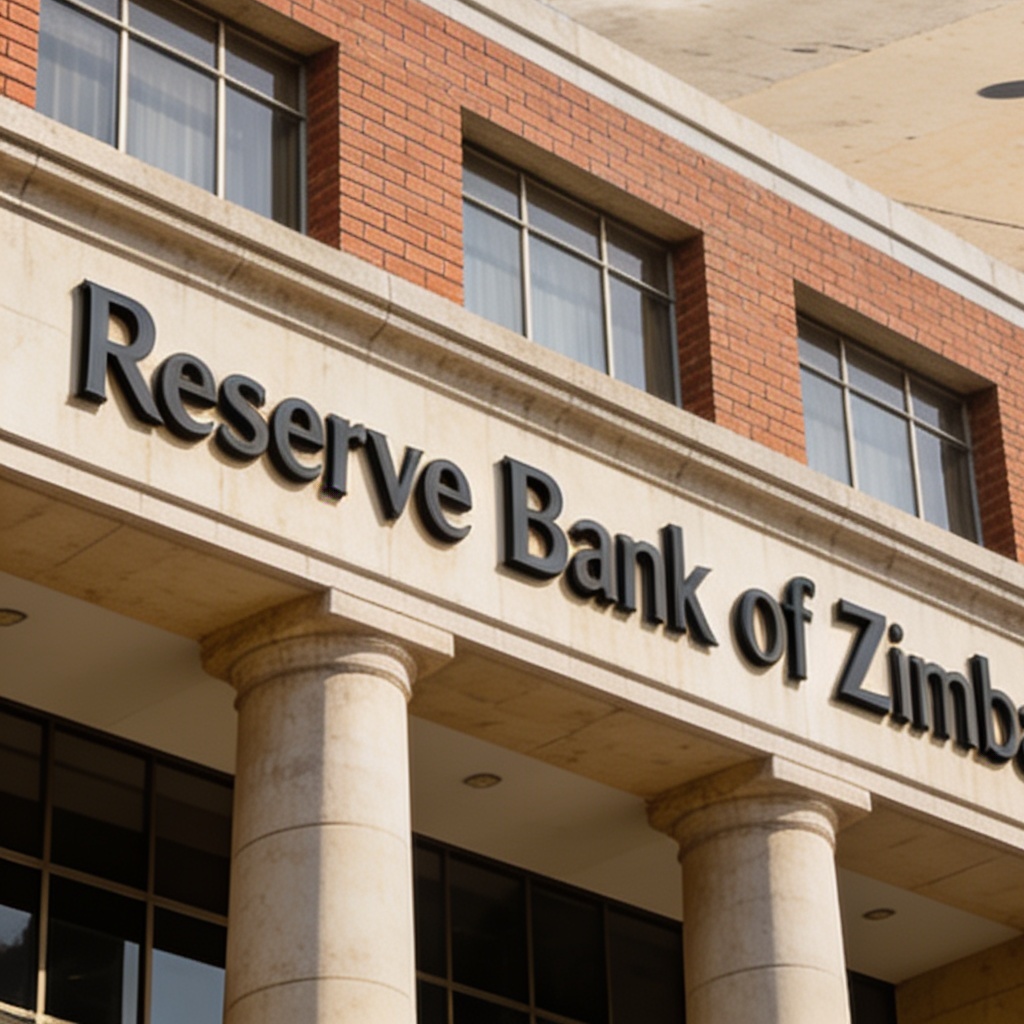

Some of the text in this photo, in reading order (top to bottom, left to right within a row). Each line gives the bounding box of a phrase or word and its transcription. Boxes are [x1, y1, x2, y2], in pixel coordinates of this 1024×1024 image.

[74, 279, 473, 544] Reserve
[499, 456, 719, 648] Bank
[731, 576, 816, 682] of
